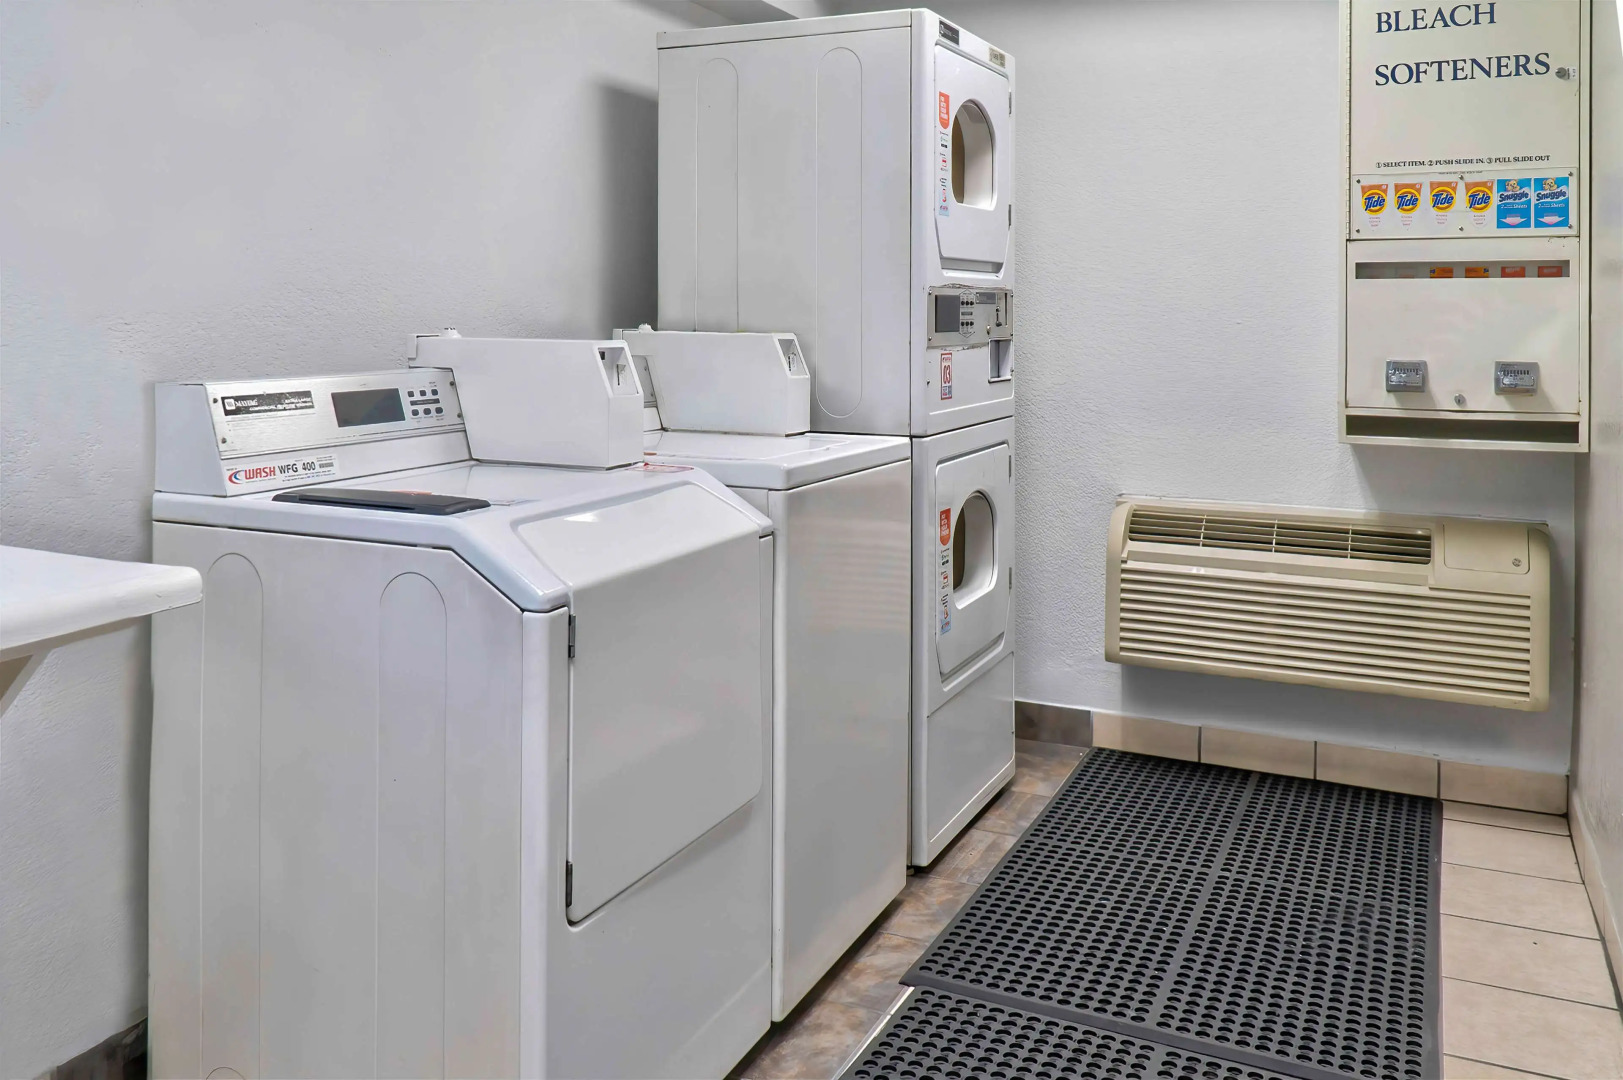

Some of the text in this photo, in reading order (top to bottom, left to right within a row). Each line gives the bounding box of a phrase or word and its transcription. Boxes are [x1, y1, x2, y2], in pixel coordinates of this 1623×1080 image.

[1376, 2, 1497, 33] BLEACH
[1375, 52, 1551, 86] SOFTENERS
[1364, 195, 1386, 211] Tide
[1397, 194, 1419, 210] Tide
[1432, 193, 1454, 208] Tide
[1468, 193, 1491, 209] Tide
[1499, 190, 1529, 202] Snuggle
[1536, 189, 1567, 201] Snuggle
[244, 466, 276, 480] WASH
[278, 463, 298, 474] WFG
[302, 461, 316, 471] 400
